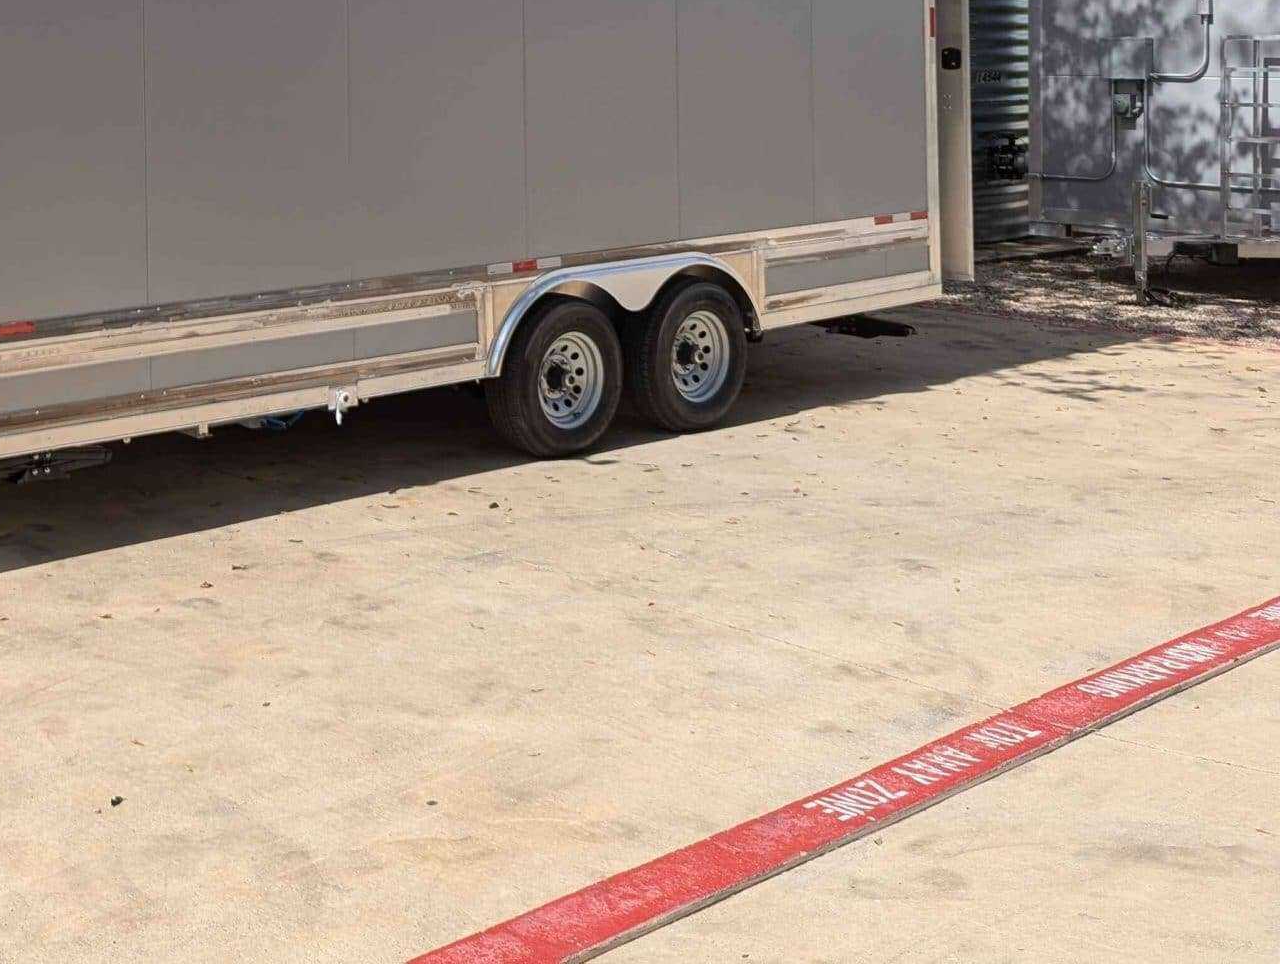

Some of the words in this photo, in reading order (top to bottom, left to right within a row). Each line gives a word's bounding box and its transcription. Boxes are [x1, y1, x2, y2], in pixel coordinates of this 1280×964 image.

[1076, 654, 1191, 697] PARKING
[964, 720, 1042, 749] TOW
[891, 745, 982, 785] AWAY
[803, 779, 908, 821] ZONE
